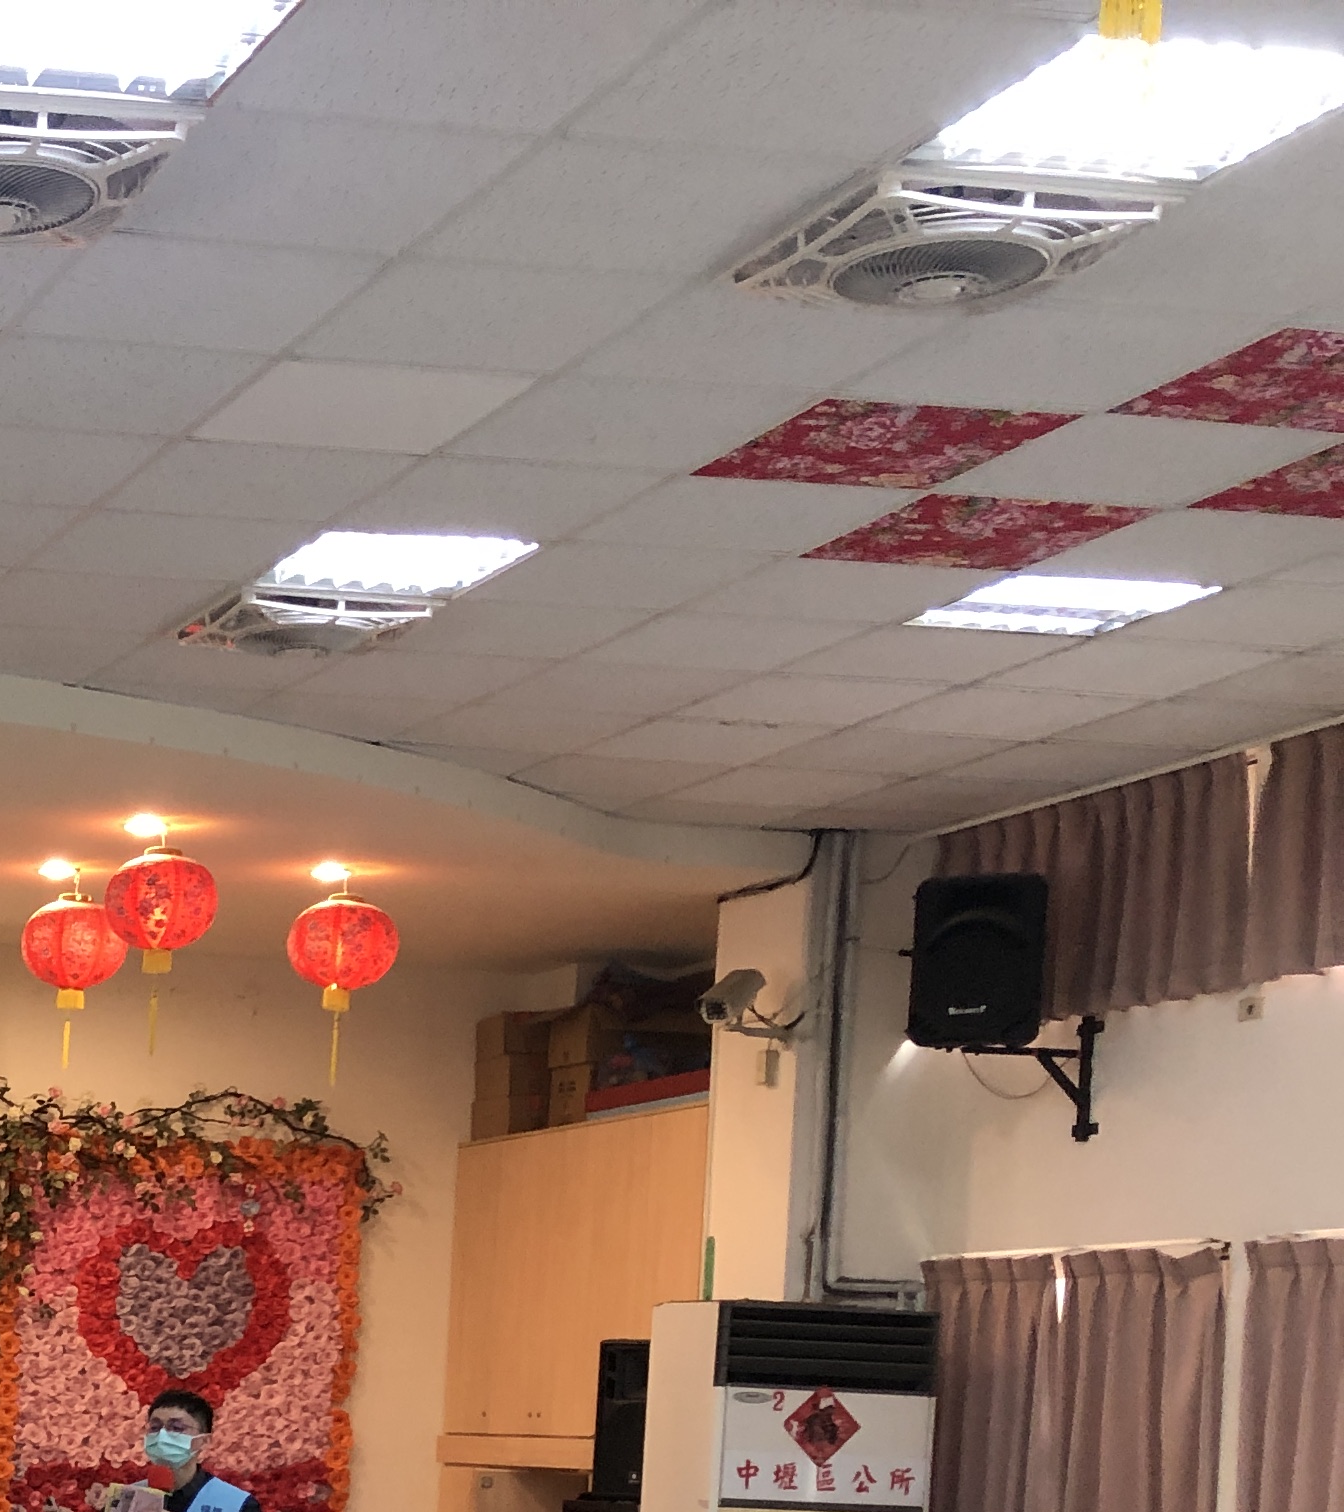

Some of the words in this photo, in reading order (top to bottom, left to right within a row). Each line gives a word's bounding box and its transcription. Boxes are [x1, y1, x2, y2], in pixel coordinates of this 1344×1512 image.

[771, 1390, 786, 1412] 2
[736, 1458, 916, 1496] 中壢區公所
